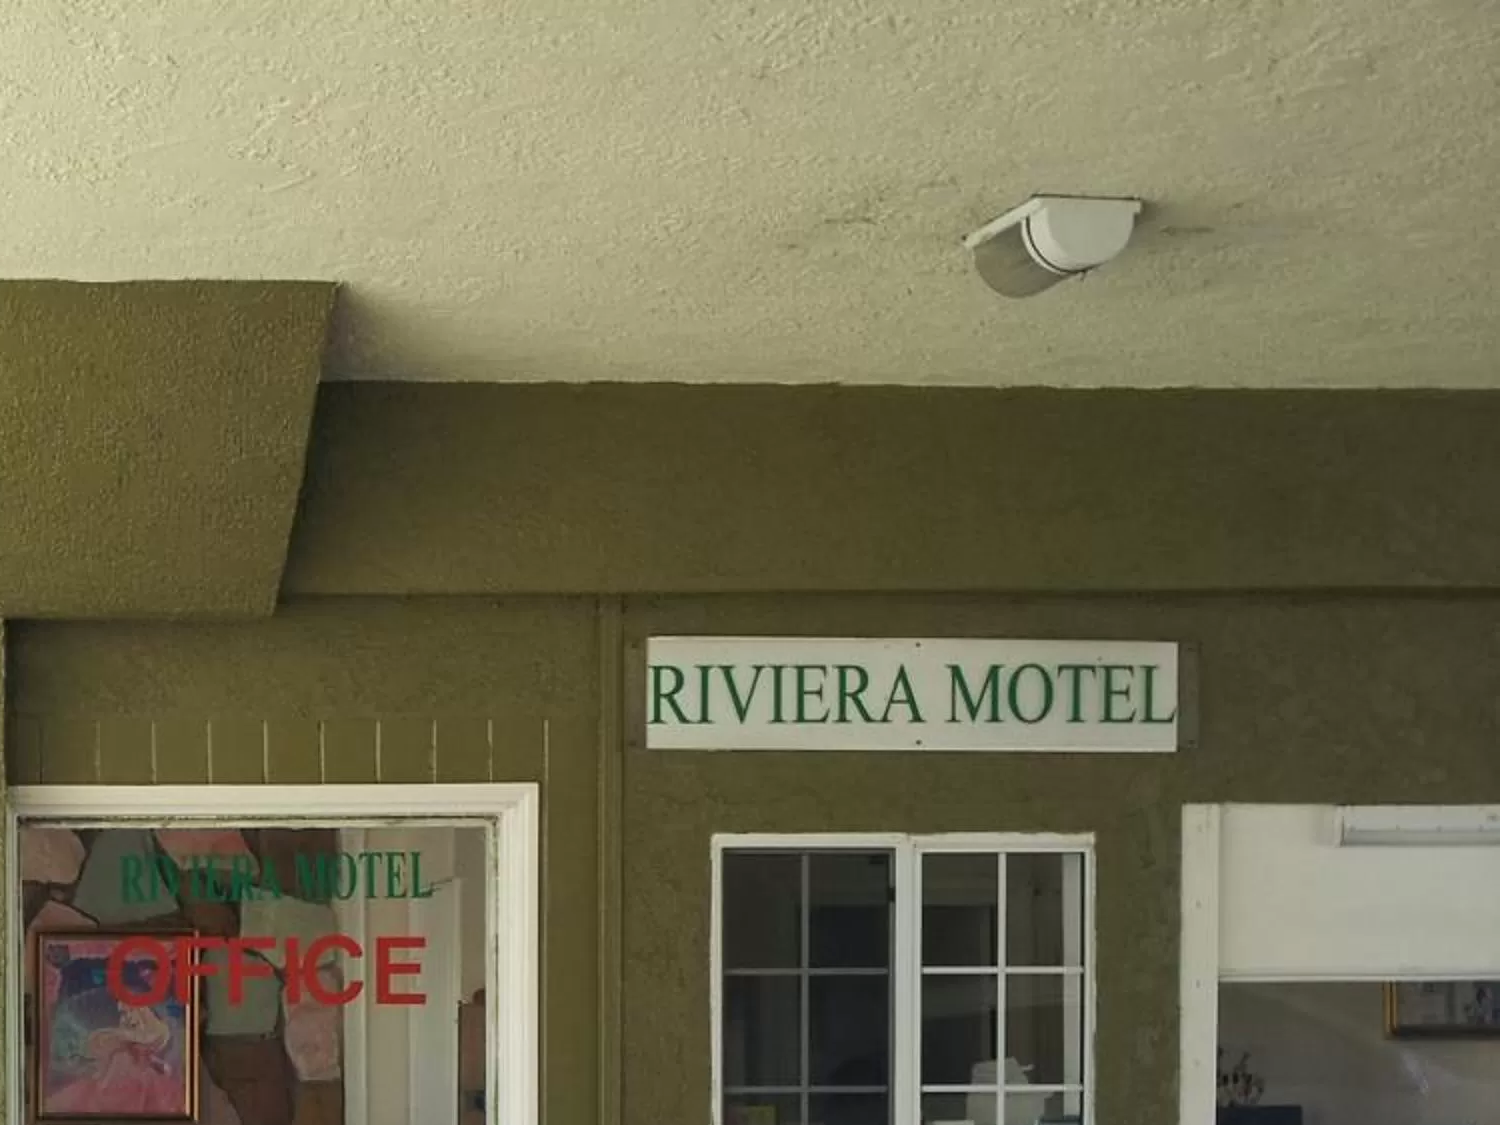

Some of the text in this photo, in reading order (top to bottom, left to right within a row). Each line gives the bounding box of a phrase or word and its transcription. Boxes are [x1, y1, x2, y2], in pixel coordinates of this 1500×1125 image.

[648, 664, 1177, 724] RIVIERA MOTEL
[120, 851, 433, 903] RIVIERA MOTEL
[108, 933, 427, 1007] OFFICE
